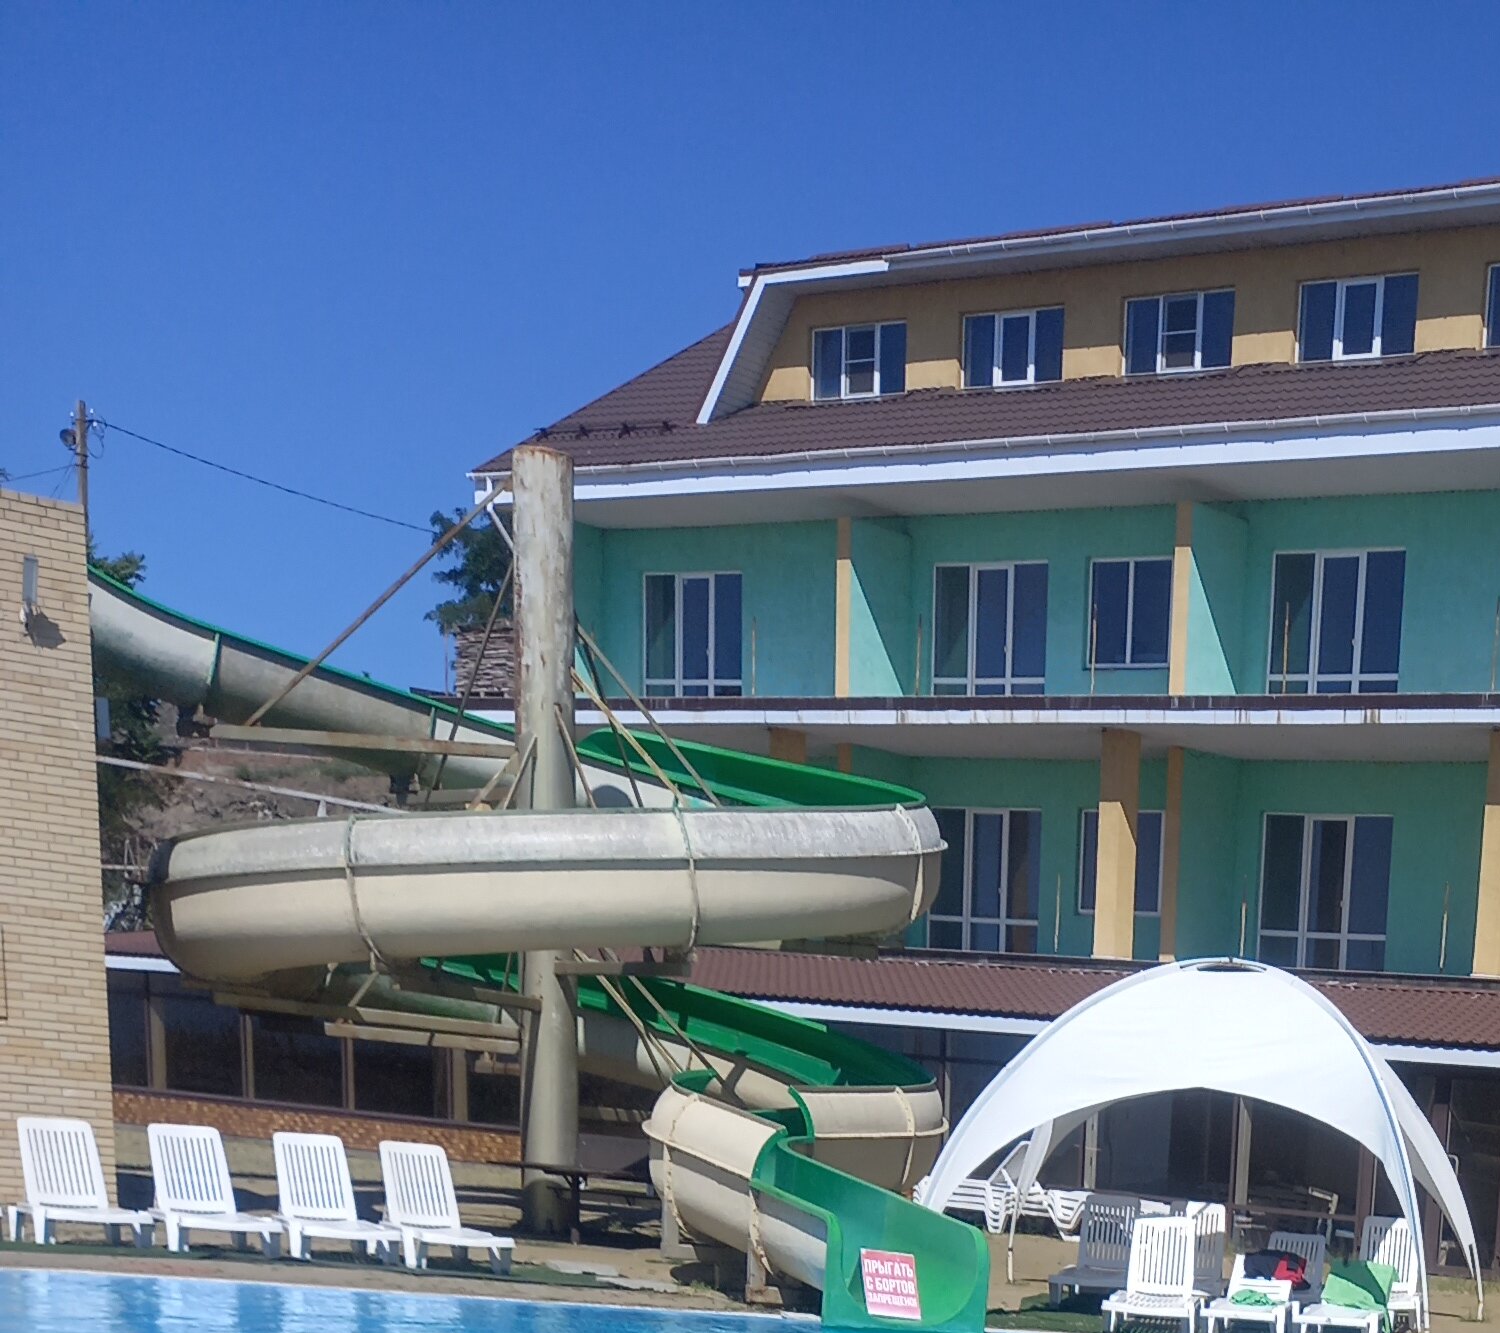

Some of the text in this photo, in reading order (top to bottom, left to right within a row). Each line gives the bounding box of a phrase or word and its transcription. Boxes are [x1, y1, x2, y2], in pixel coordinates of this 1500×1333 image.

[863, 1259, 913, 1277] ПРЫГАТЬ
[866, 1276, 915, 1295] С БОРТОВ
